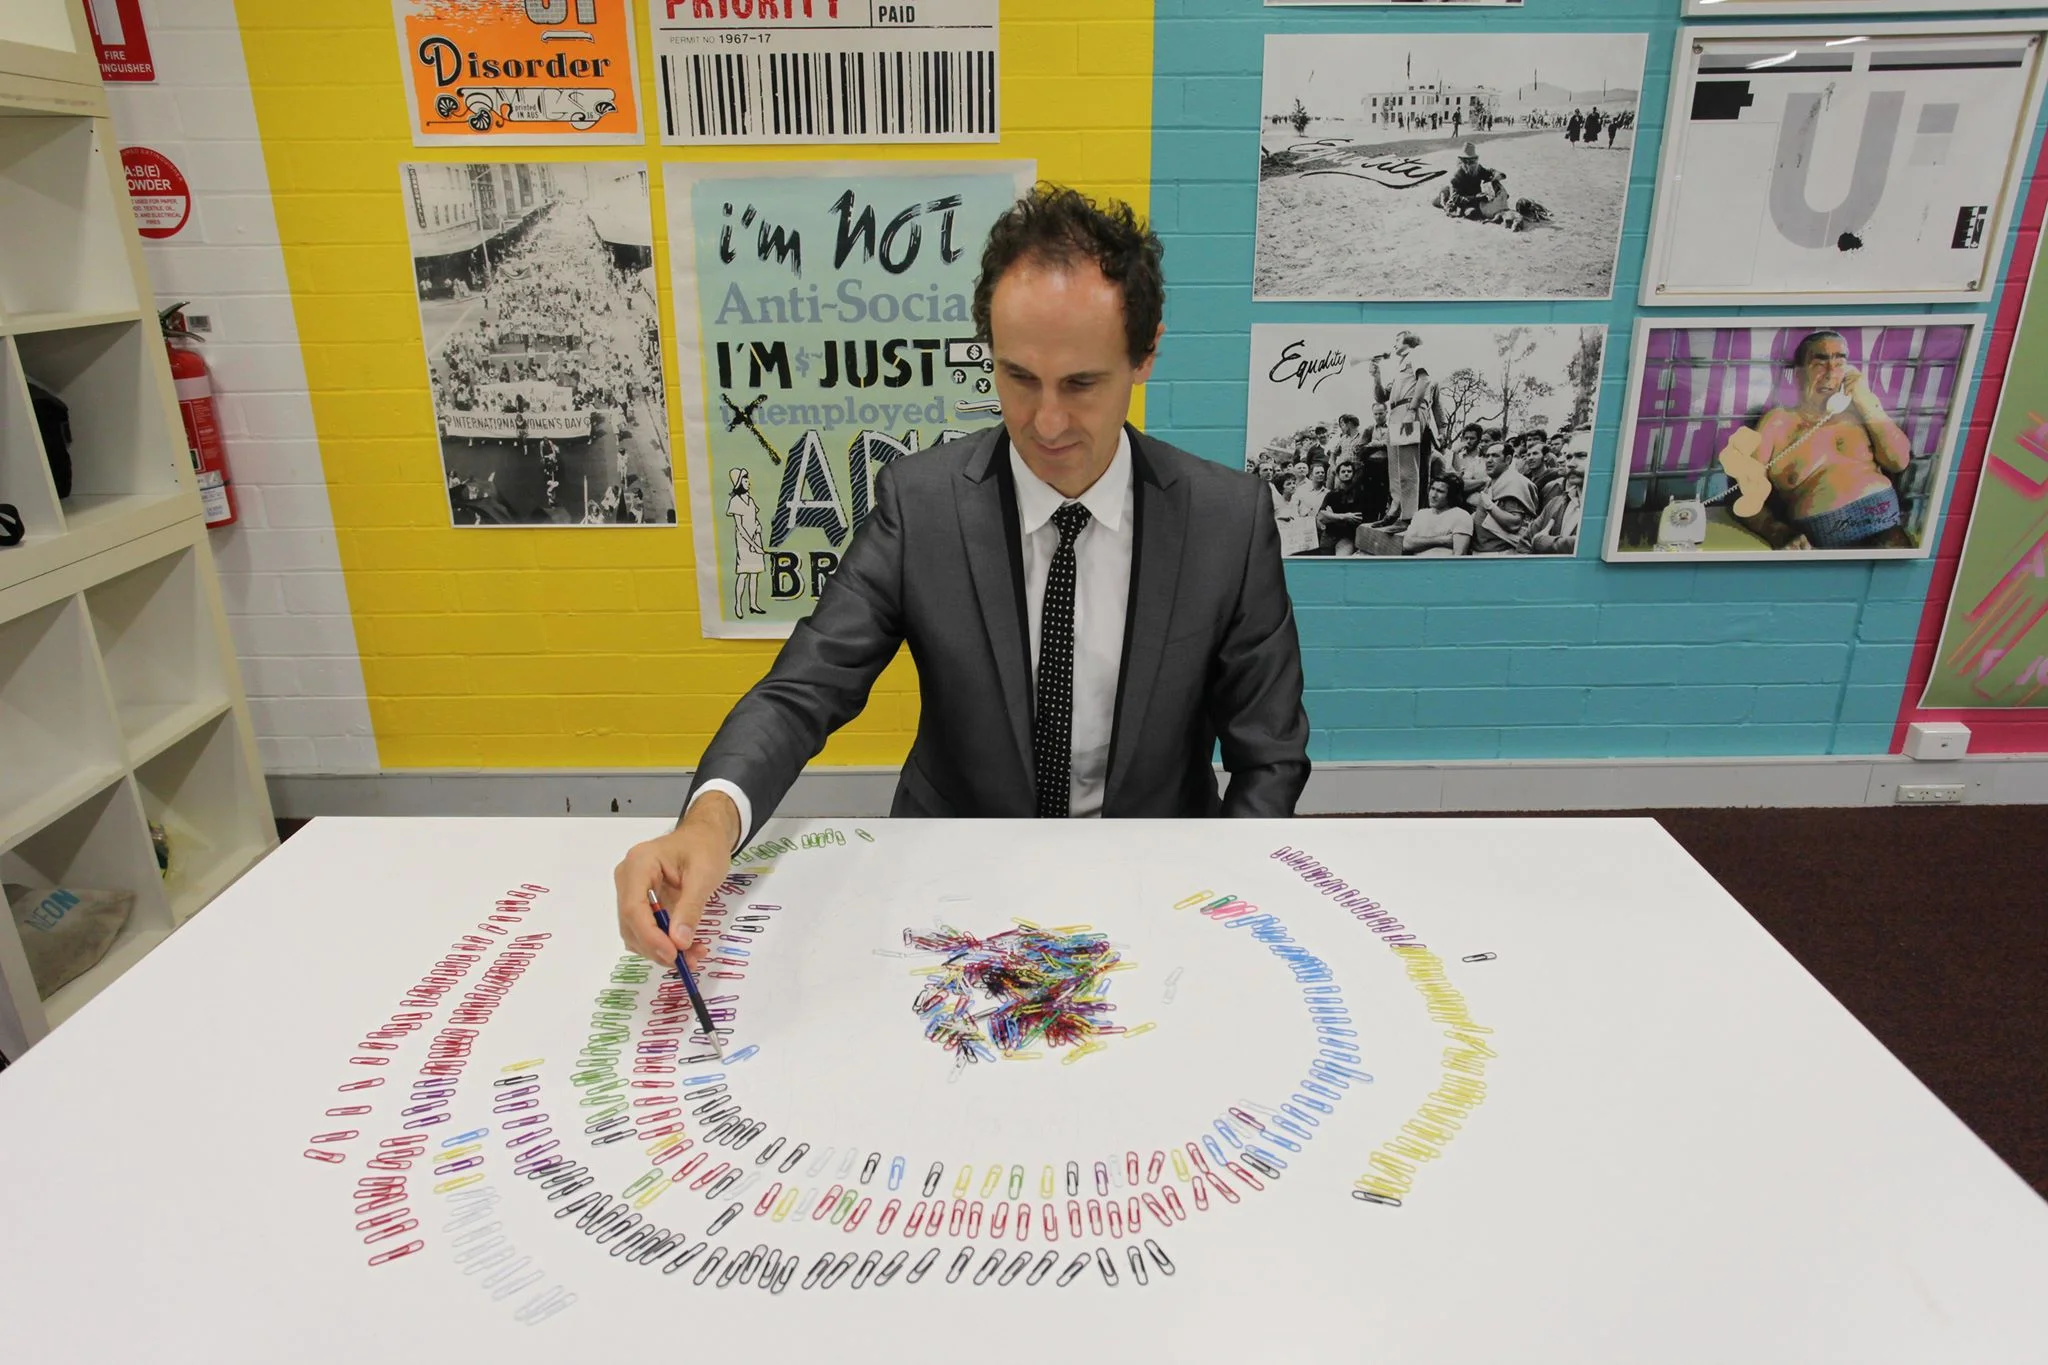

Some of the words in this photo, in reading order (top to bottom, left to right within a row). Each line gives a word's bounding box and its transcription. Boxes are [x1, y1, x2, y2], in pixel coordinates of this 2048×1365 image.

[879, 5, 915, 22] PAID
[670, 36, 700, 44] PERMIT
[703, 36, 715, 44] NO
[719, 33, 771, 43] 1967-17
[104, 50, 126, 60] FIRE
[418, 36, 611, 87] Disorder
[101, 63, 152, 73] INGUISHER
[515, 104, 537, 112] printed
[127, 179, 172, 191] OWDER
[714, 278, 973, 325] Anti-Socia
[716, 340, 793, 389] I'M
[820, 339, 941, 389] JUST
[1269, 339, 1346, 394] Equality
[453, 415, 518, 430] INTERNATIONA
[564, 416, 582, 430] DAY
[24, 889, 80, 932] NEON
